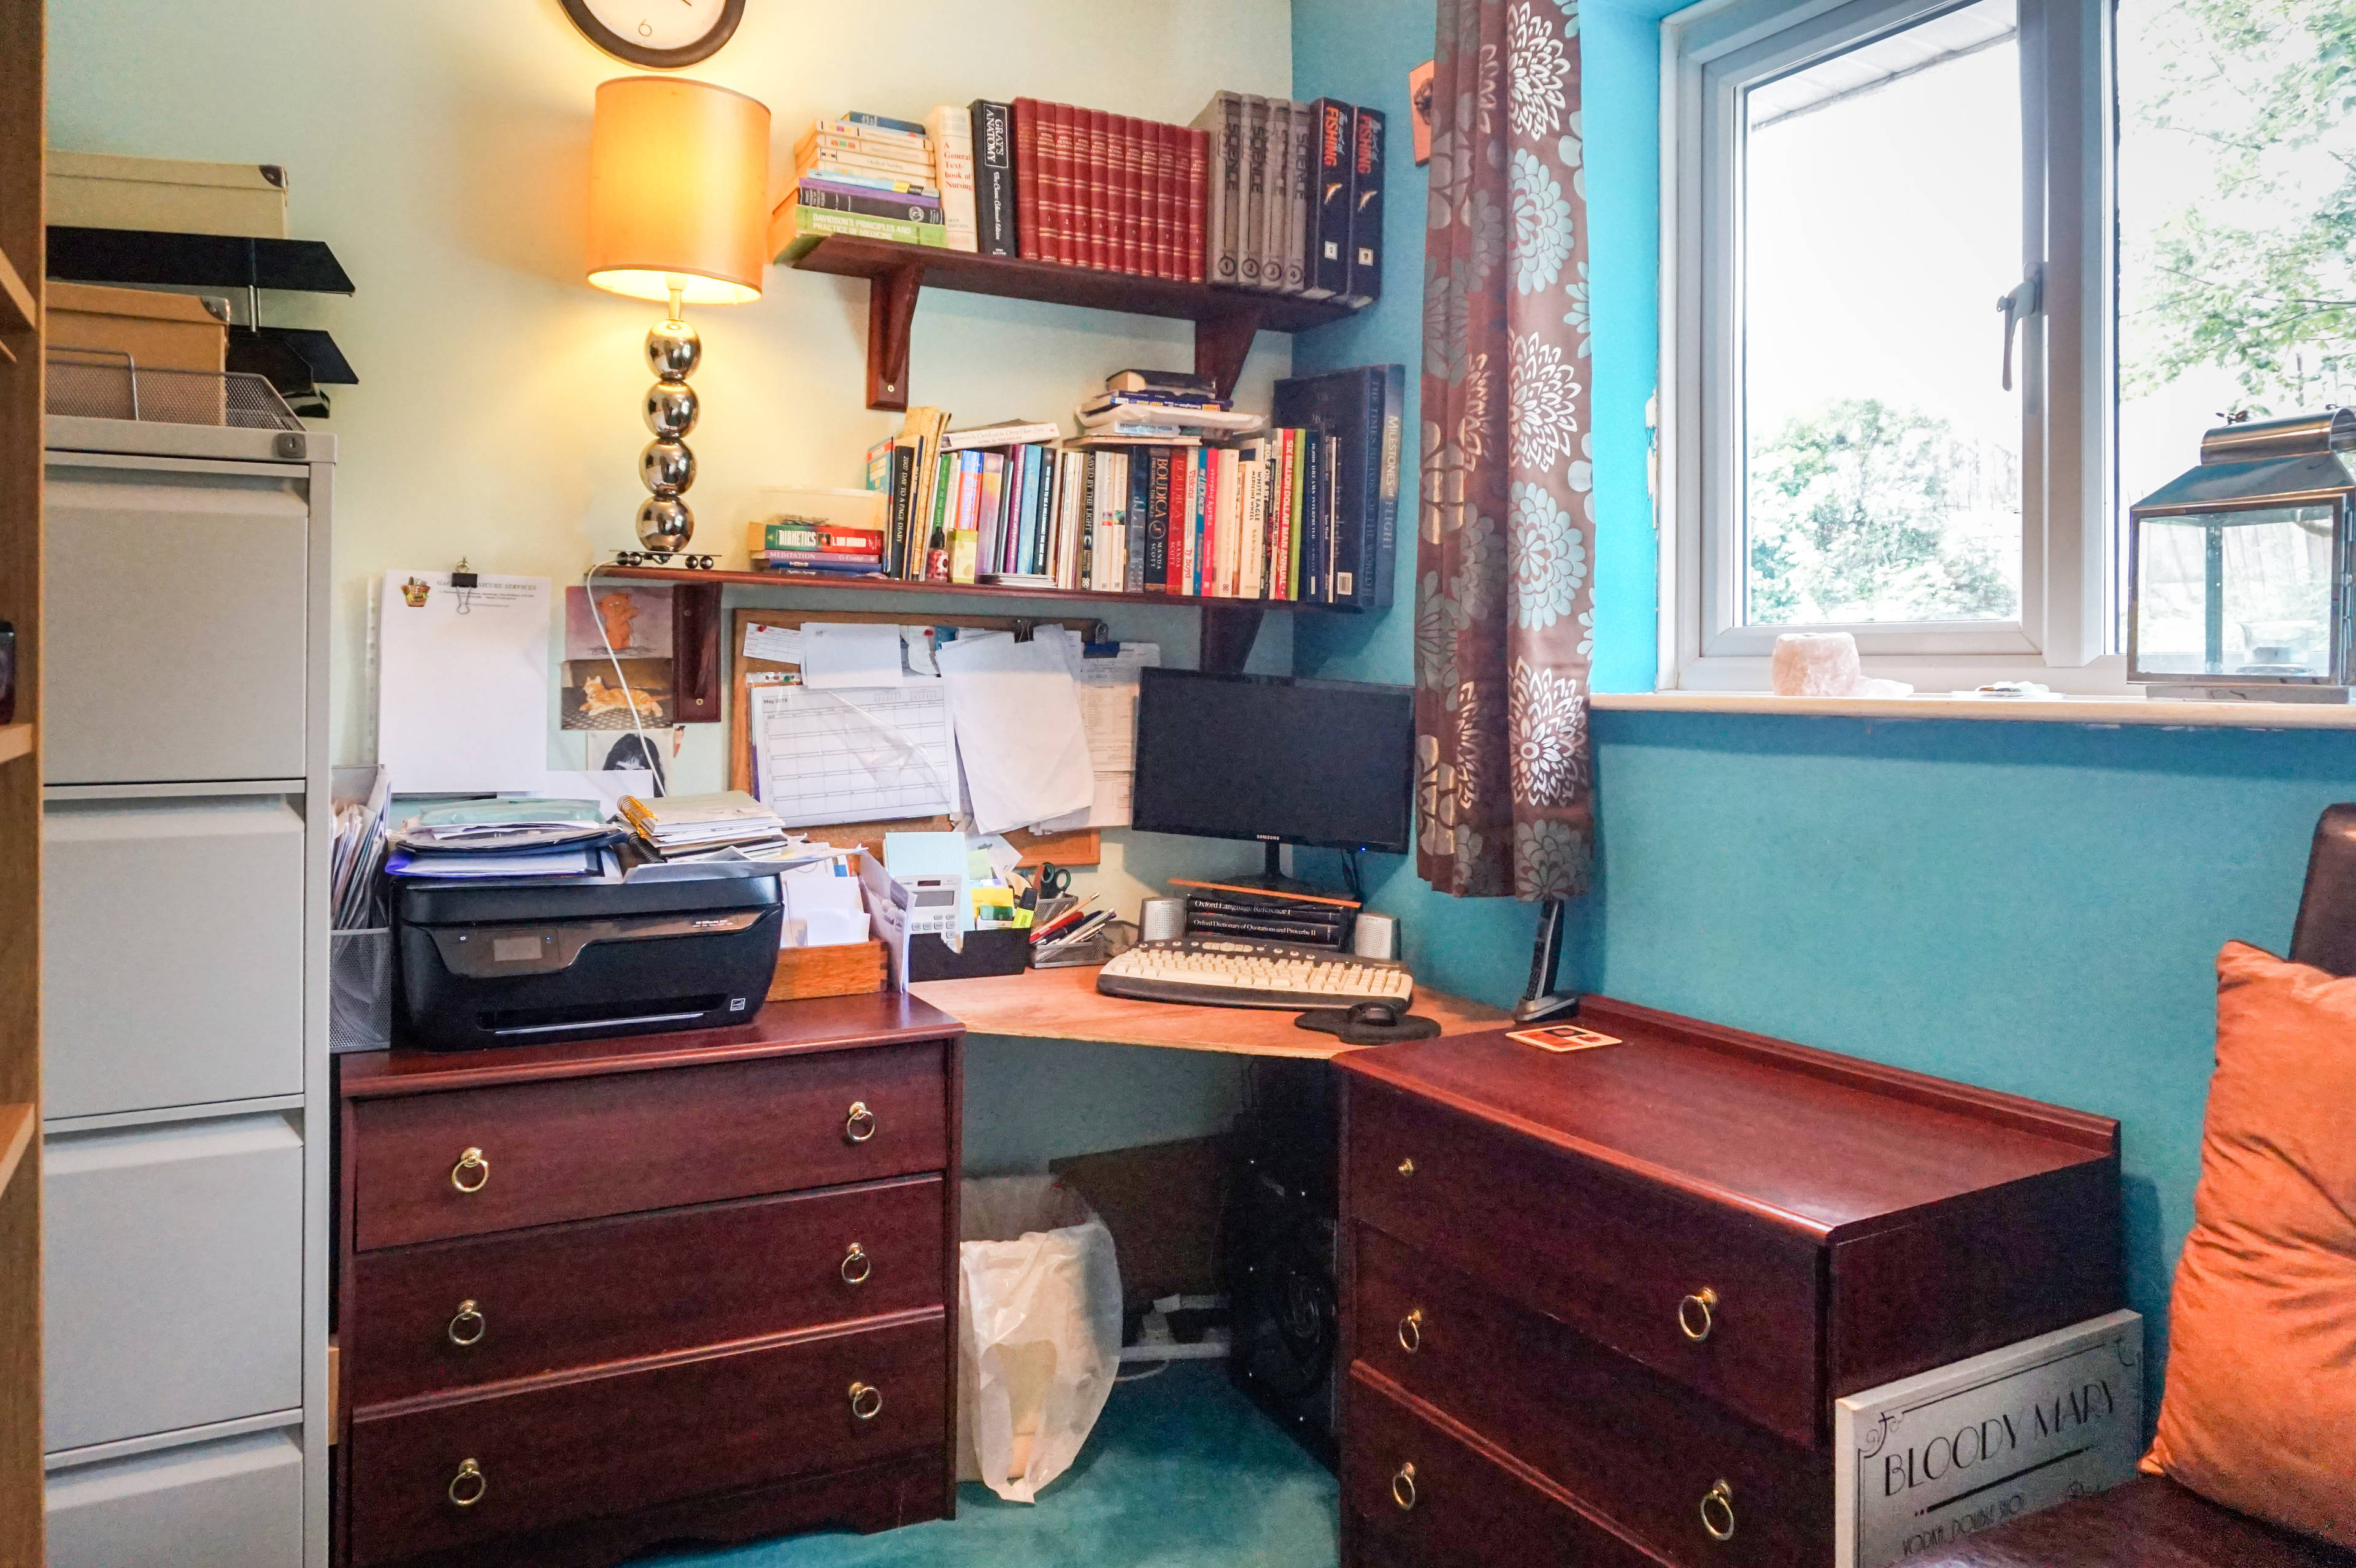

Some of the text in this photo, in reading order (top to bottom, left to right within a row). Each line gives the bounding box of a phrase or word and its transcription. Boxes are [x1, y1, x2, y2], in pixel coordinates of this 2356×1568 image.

[638, 19, 652, 37] 6
[986, 109, 996, 163] ANATOMY
[1323, 106, 1339, 167] FISHING
[1357, 115, 1372, 174] FISHING
[944, 150, 971, 161] General
[1295, 133, 1309, 199] SCIENCE
[945, 182, 972, 191] Nursing
[813, 213, 911, 235] DAVIDSON'S PRINCIPLES AND
[813, 223, 847, 234] PRACTICE
[849, 228, 858, 237] OF
[1248, 263, 1254, 272] 2
[1284, 455, 1293, 490] MILLION
[1382, 415, 1399, 550] MILESTONES of FLIGHT
[901, 486, 907, 496] TO
[1087, 480, 1093, 489] BY
[1155, 458, 1168, 518] BOUDICA
[1174, 459, 1185, 518] BOUDICA
[1282, 491, 1292, 525] DOLLAR
[779, 530, 816, 546] DIANETICS
[1280, 526, 1289, 548] MAN
[770, 551, 815, 559] MEDITATION
[1279, 548, 1288, 585] ANNUAL
[1195, 900, 1218, 910] Oxford
[1218, 902, 1252, 913] Language
[1253, 905, 1286, 915] Reference
[1213, 921, 1240, 930] Dictionary
[1247, 924, 1275, 932] Quotations
[1885, 1380, 2115, 1496] BLOODY MARY
